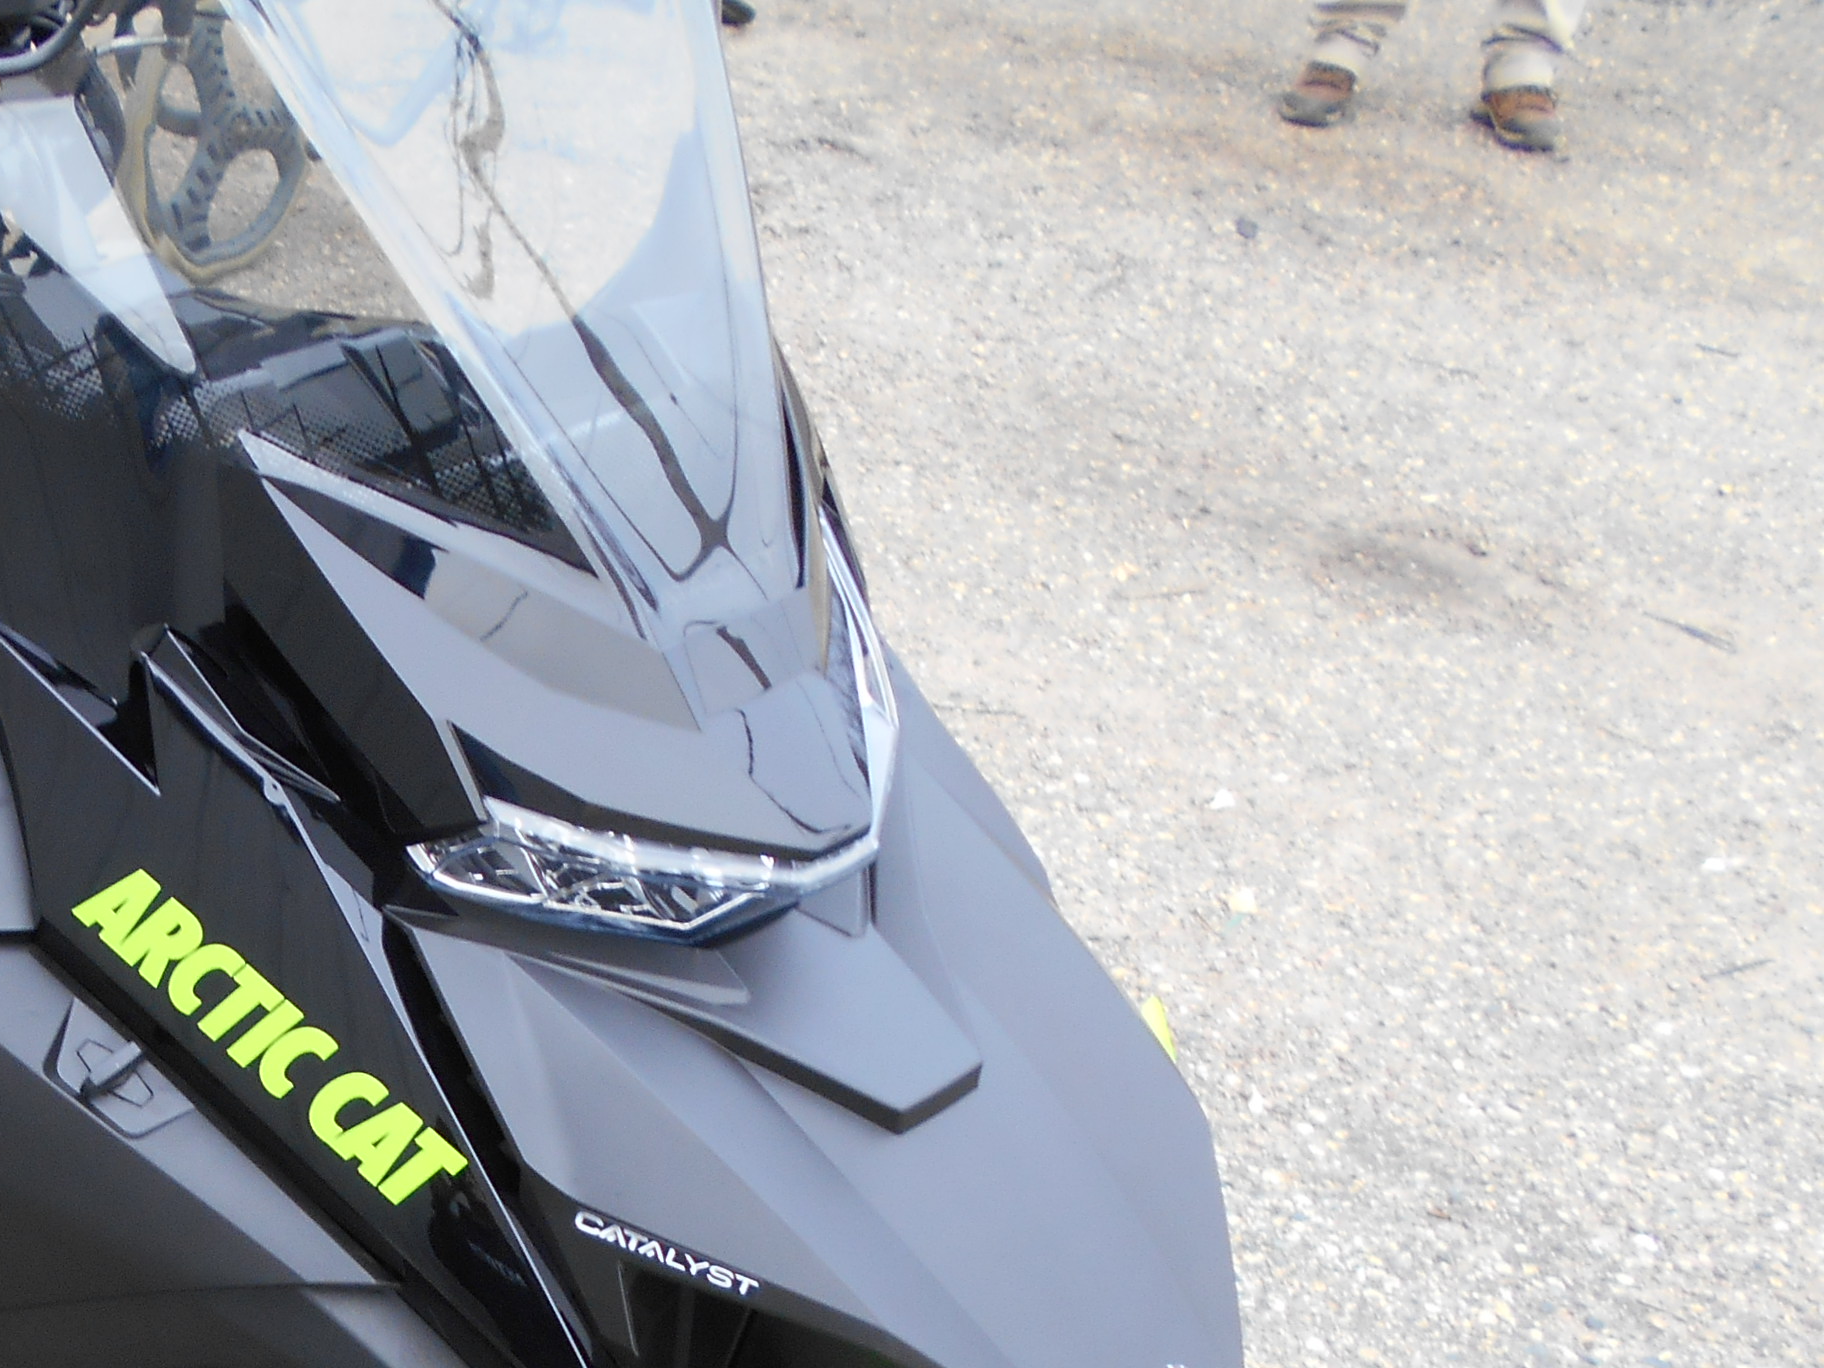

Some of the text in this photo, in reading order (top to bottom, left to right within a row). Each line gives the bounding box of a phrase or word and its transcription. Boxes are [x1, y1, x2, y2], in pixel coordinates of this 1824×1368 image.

[71, 868, 469, 1206] ARCTIC CAT
[574, 1211, 760, 1296] CATALYST
